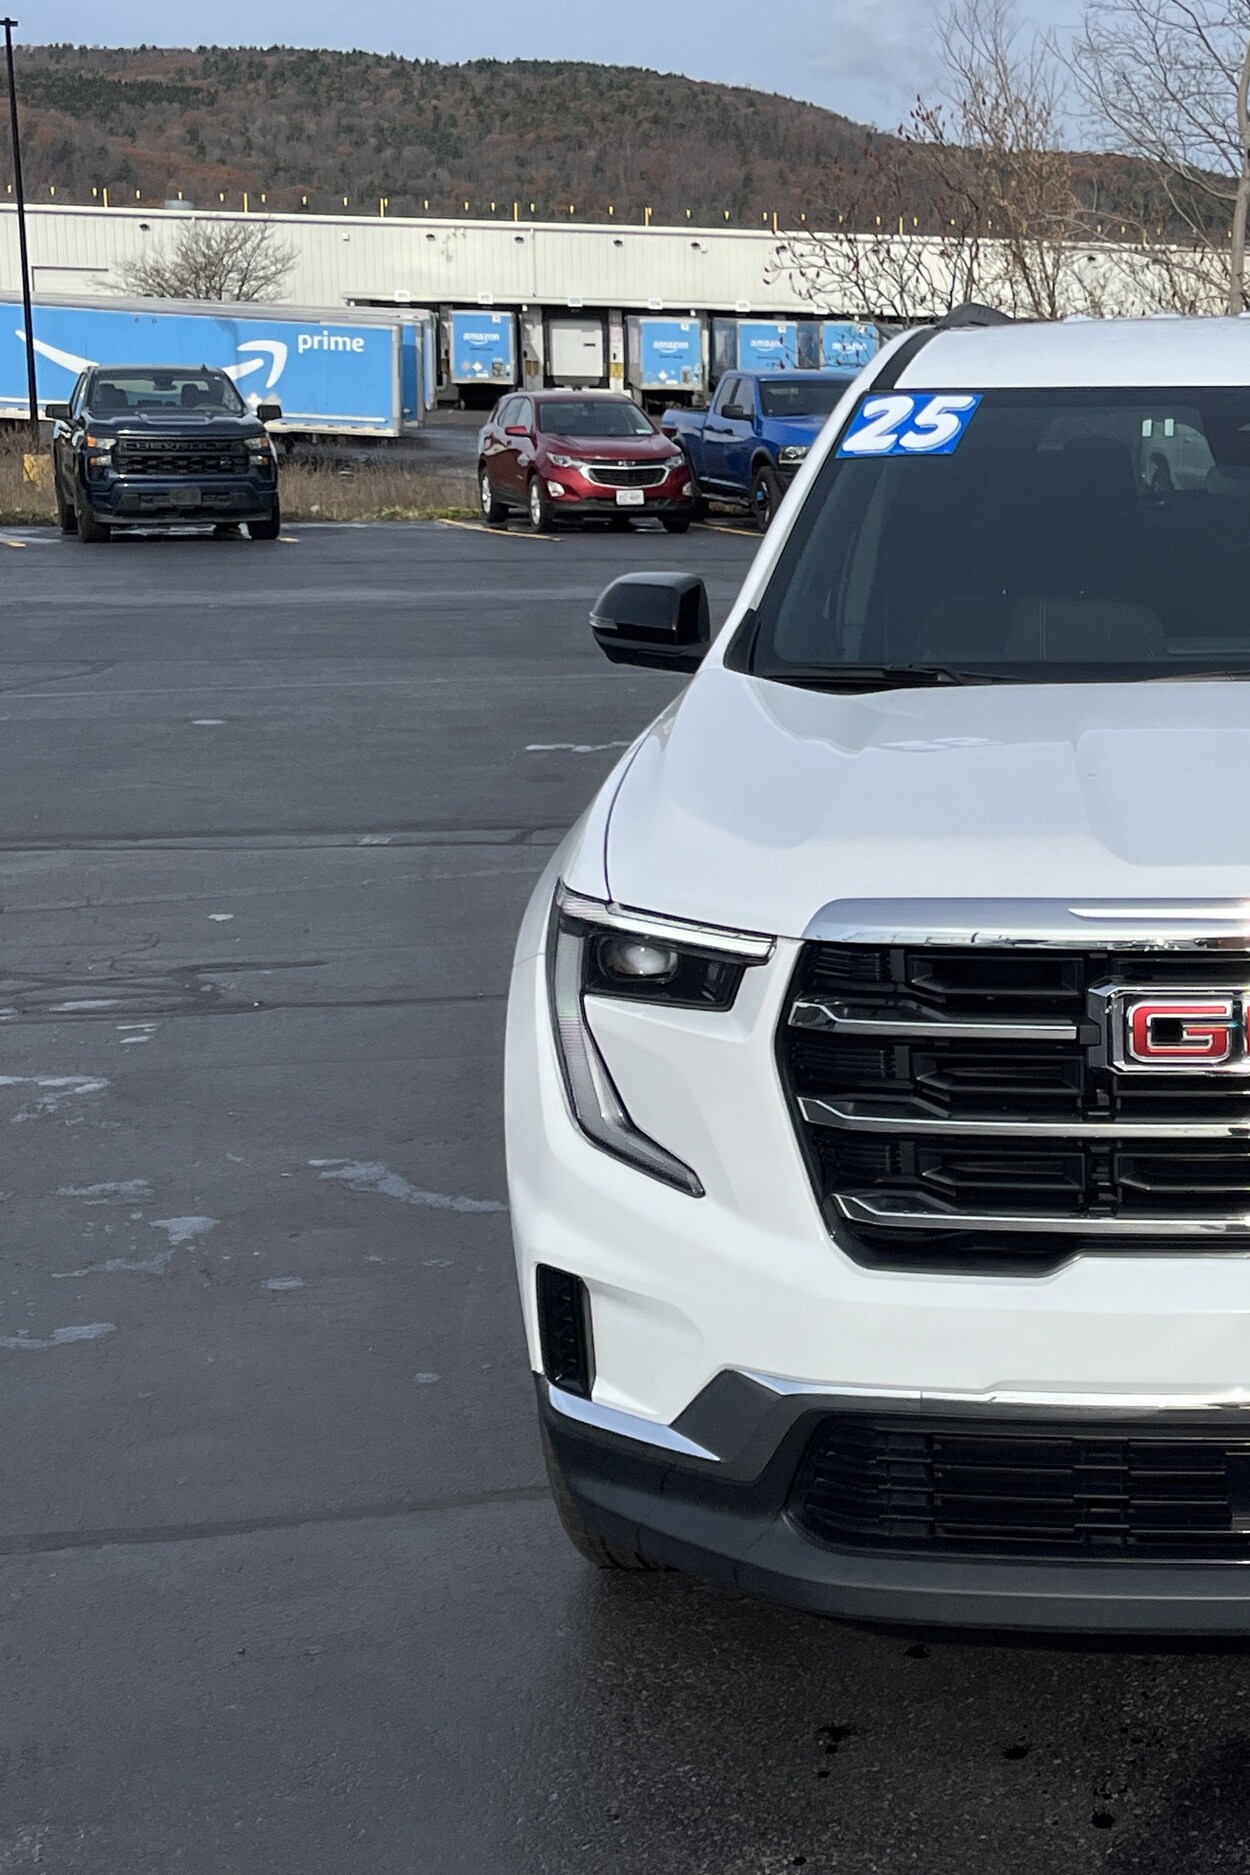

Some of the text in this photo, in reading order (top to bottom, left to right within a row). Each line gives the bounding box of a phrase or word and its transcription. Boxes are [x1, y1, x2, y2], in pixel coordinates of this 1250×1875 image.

[297, 330, 365, 354] prime
[463, 332, 500, 342] amazon
[653, 341, 689, 350] amazon
[841, 395, 976, 455] 25
